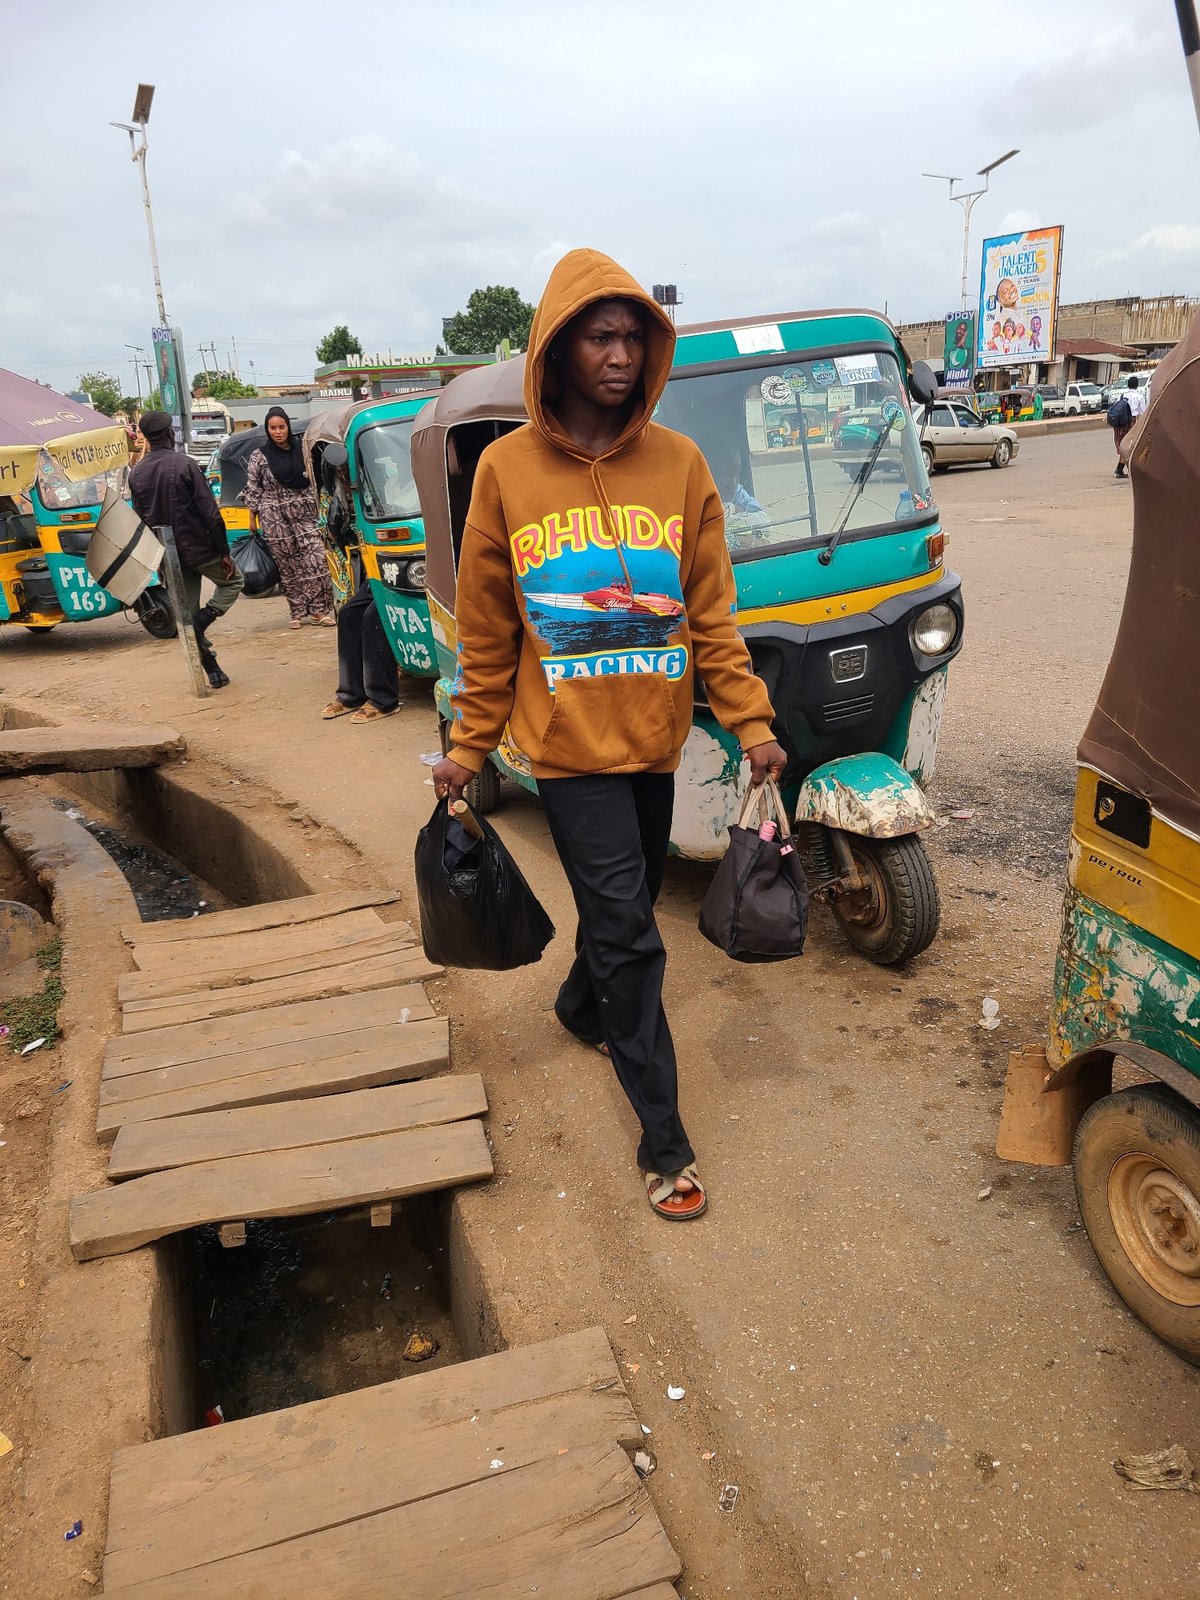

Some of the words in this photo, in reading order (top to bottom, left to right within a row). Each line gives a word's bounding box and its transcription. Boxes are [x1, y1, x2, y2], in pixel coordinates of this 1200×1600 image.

[1000, 251, 1036, 267] TALENT
[998, 263, 1038, 278] UNCAGED
[945, 310, 975, 323] OPay
[346, 353, 435, 367] MAINLAND
[848, 371, 873, 381] UNIT
[946, 369, 969, 380] Night
[95, 447, 103, 459] to
[71, 591, 107, 612] 169
[543, 652, 682, 687] RACING
